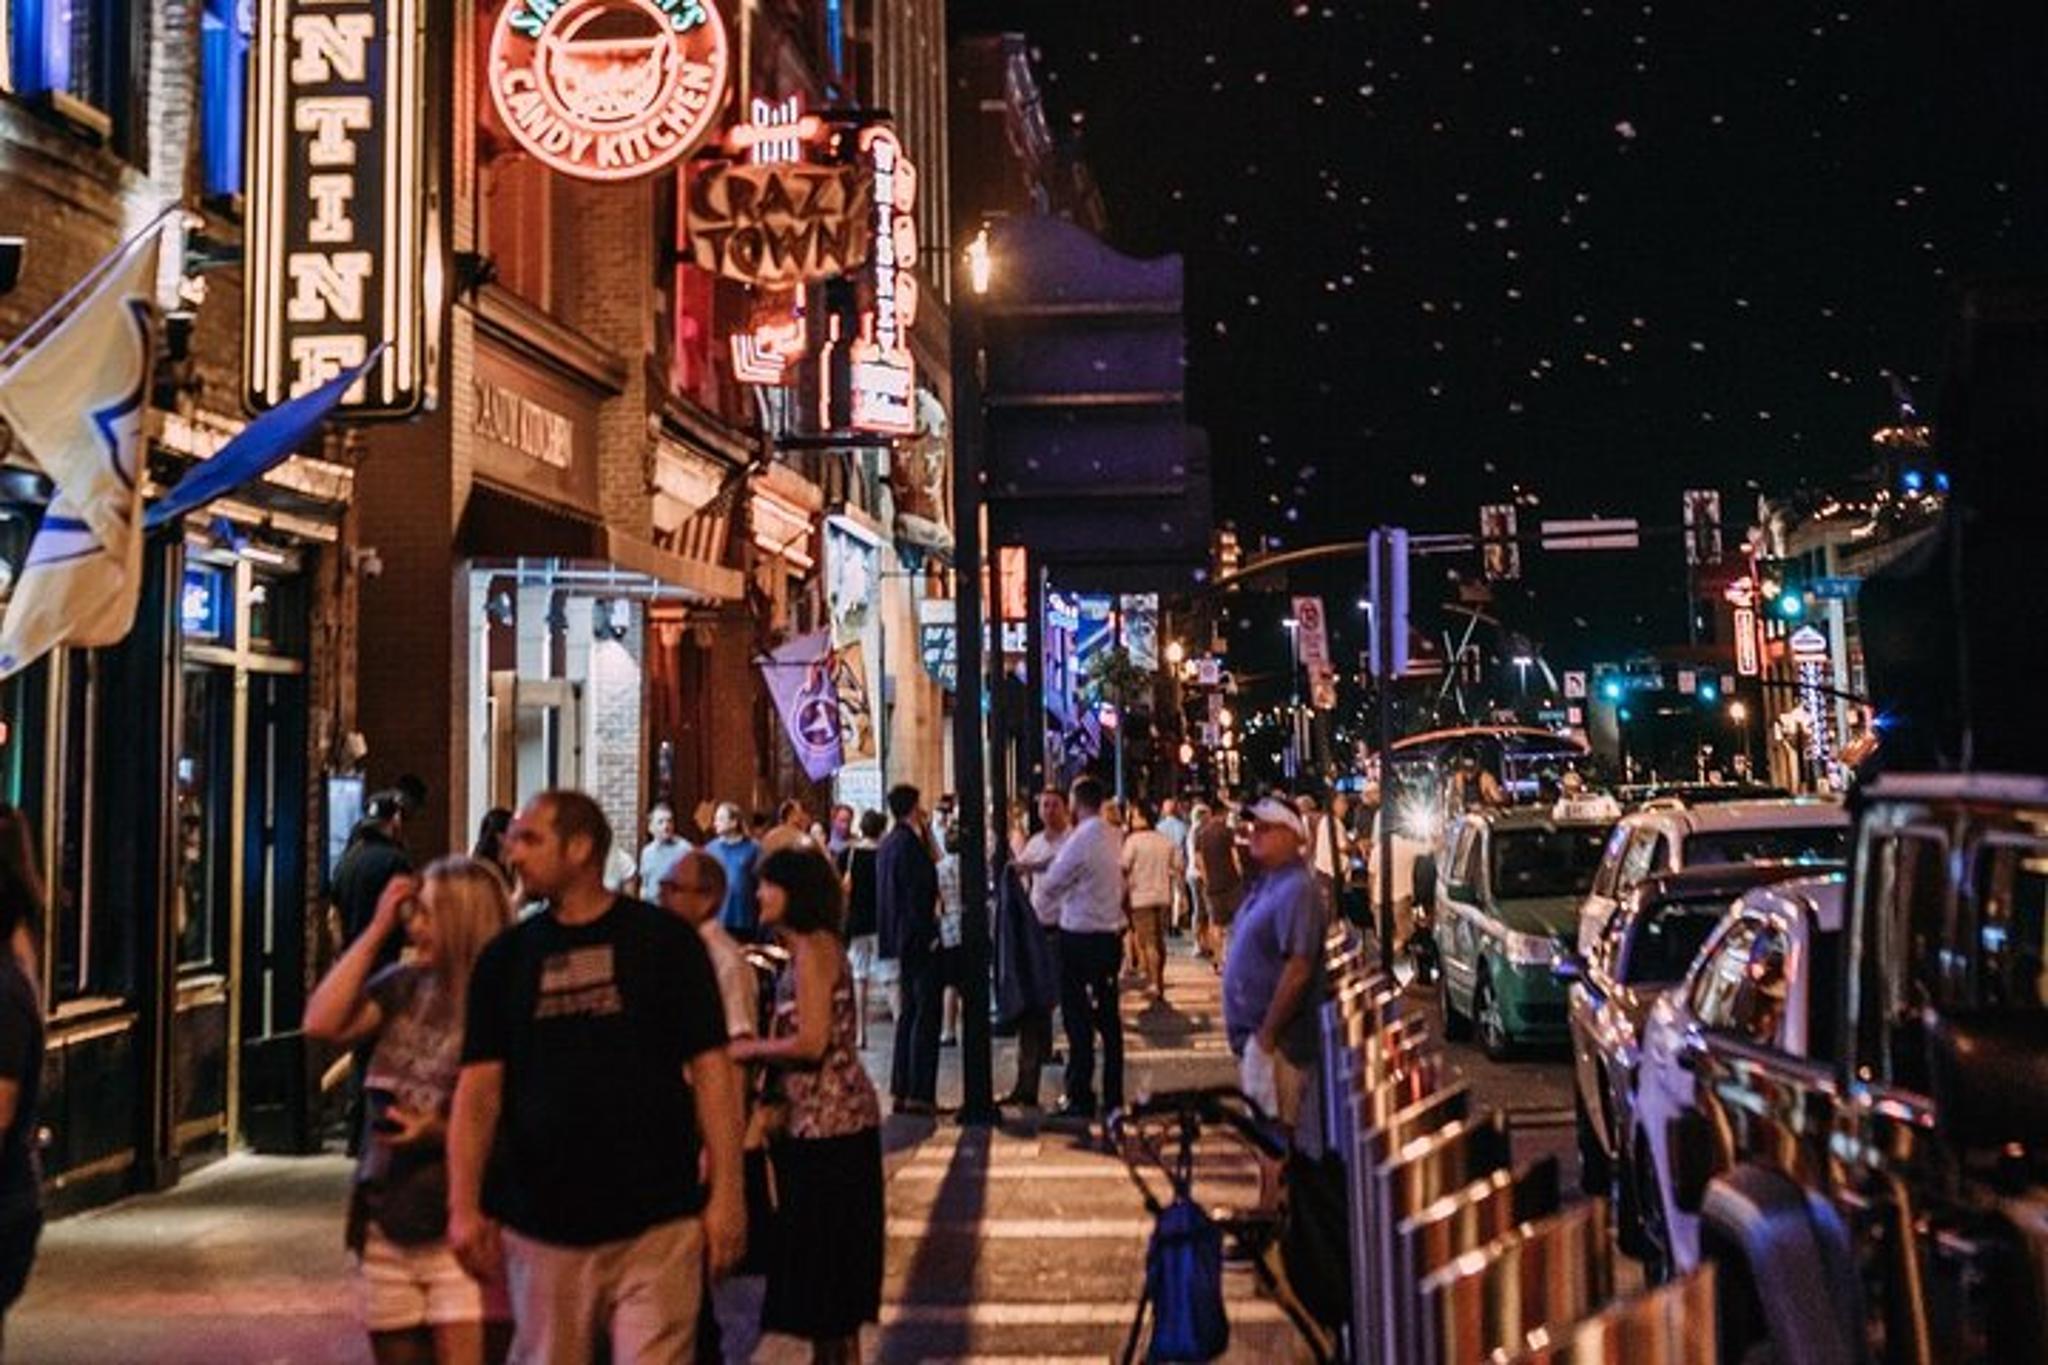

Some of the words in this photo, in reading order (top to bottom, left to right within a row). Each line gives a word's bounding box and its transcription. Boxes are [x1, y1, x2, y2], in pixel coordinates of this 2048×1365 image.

[503, 69, 592, 163] CANDY
[597, 62, 713, 169] KITCHEN
[689, 162, 872, 222] CRAZY
[695, 217, 850, 280] TOWN
